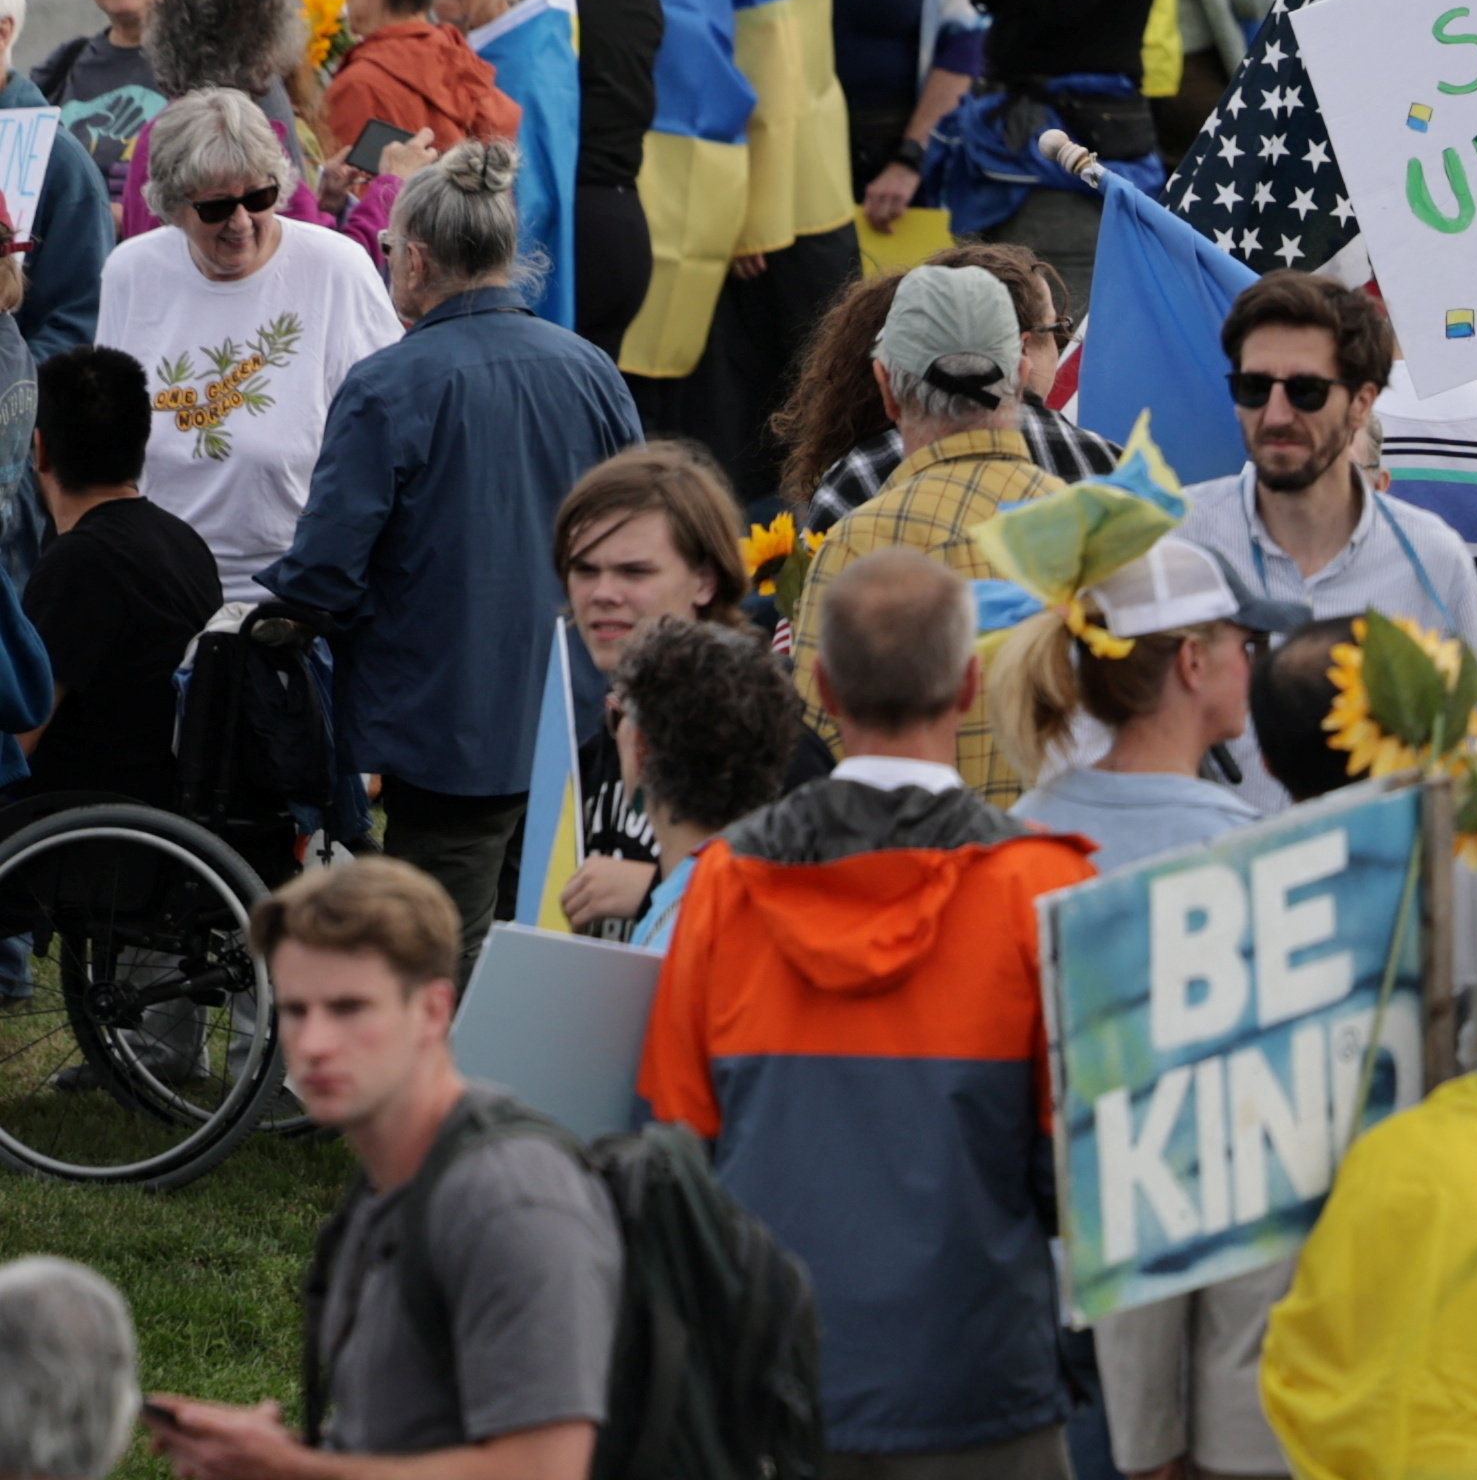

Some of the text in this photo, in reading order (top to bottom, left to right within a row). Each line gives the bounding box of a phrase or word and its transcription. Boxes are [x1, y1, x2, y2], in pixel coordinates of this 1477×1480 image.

[155, 354, 264, 410] ONE GREEN
[176, 389, 244, 431] WORLD
[1149, 828, 1355, 1051] BE
